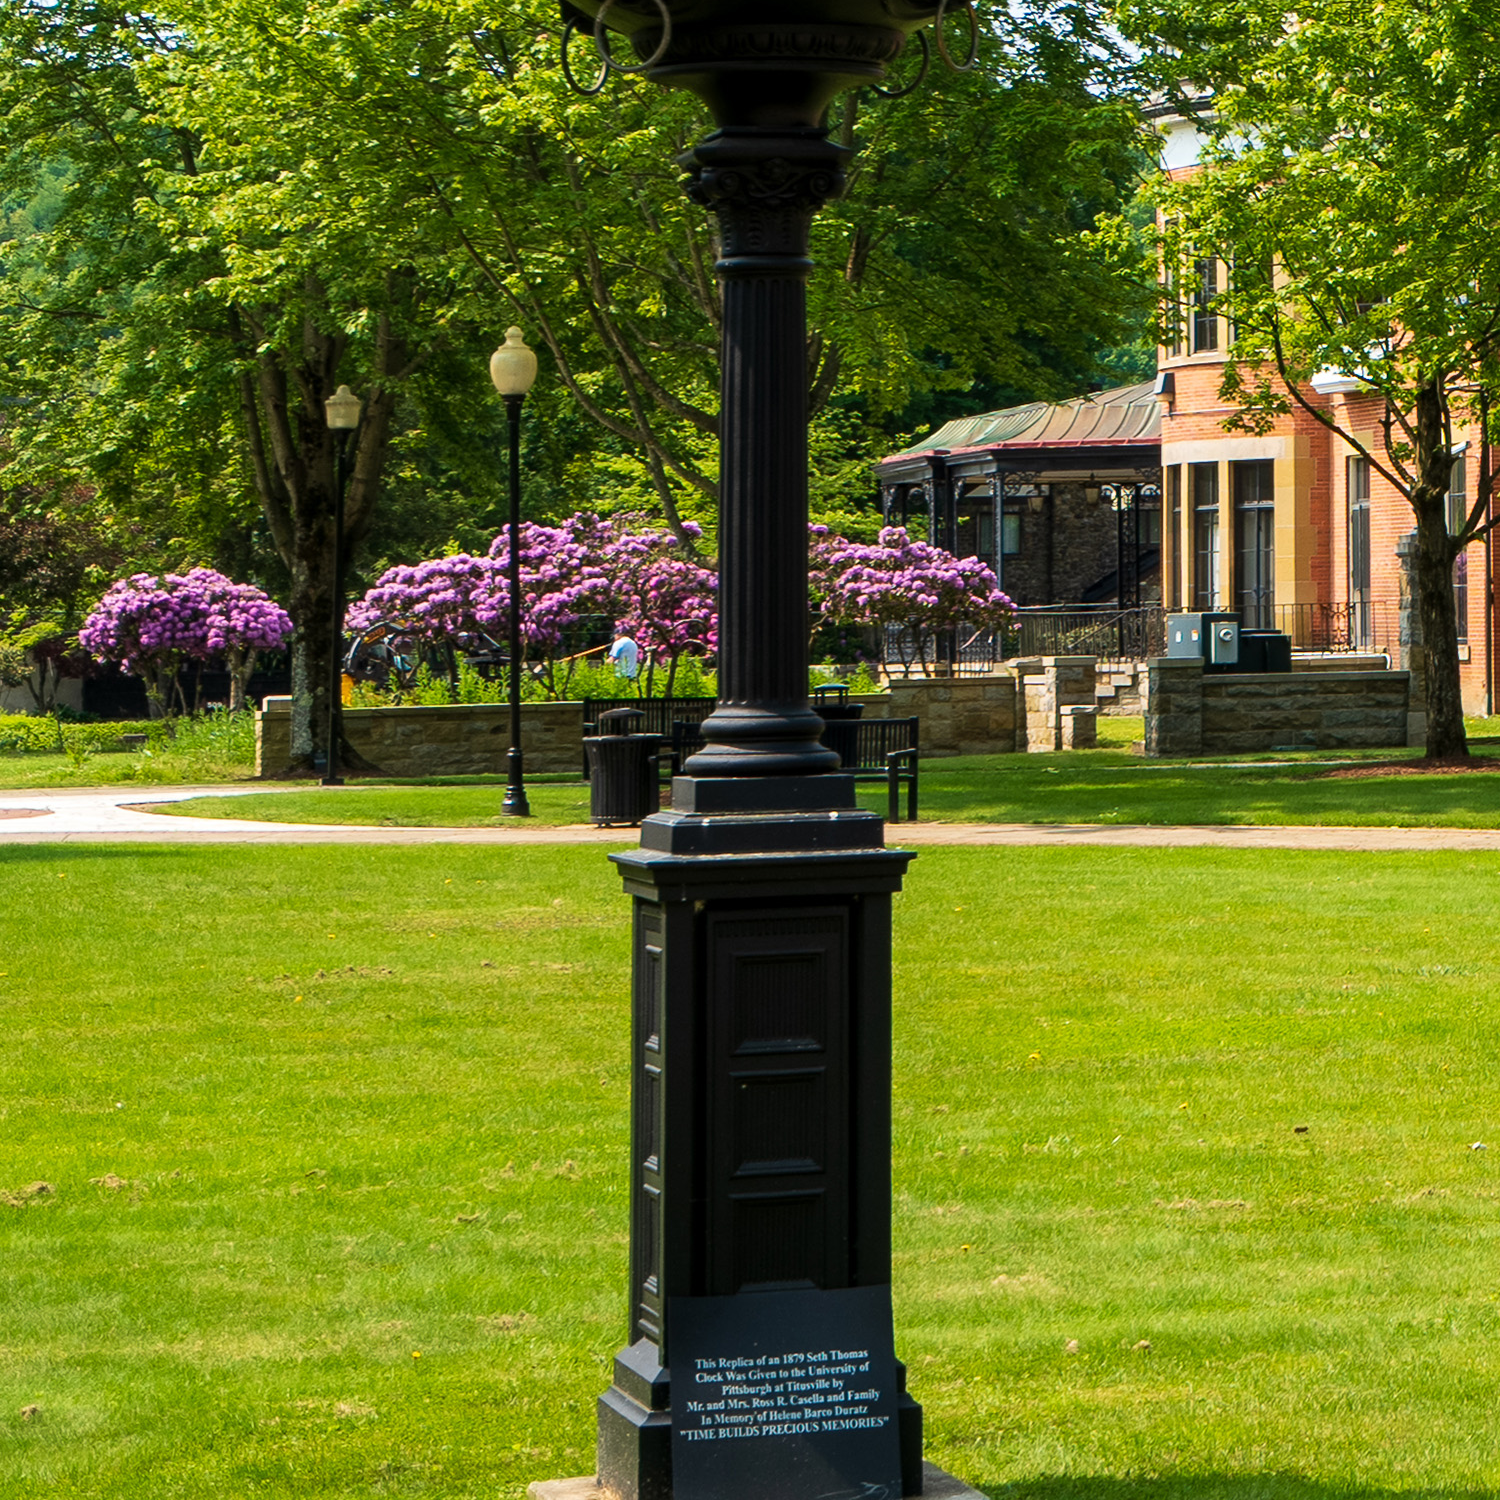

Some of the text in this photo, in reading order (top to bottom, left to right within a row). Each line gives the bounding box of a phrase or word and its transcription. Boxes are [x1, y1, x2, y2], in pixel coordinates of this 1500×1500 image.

[695, 1350, 868, 1370] This Replica of an 1879 Seth Thomas
[696, 1362, 870, 1383] Clock Was Given to the University of
[722, 1378, 844, 1396] Pittsburgh at Titusville by
[687, 1389, 880, 1412] Mr. and Mrs. Ross R. Casella and Family
[701, 1405, 868, 1425] In Memory of Helene Barco Duratz
[680, 1416, 890, 1441] "TIME BUILDS PRECIOUS MEMORIES"
